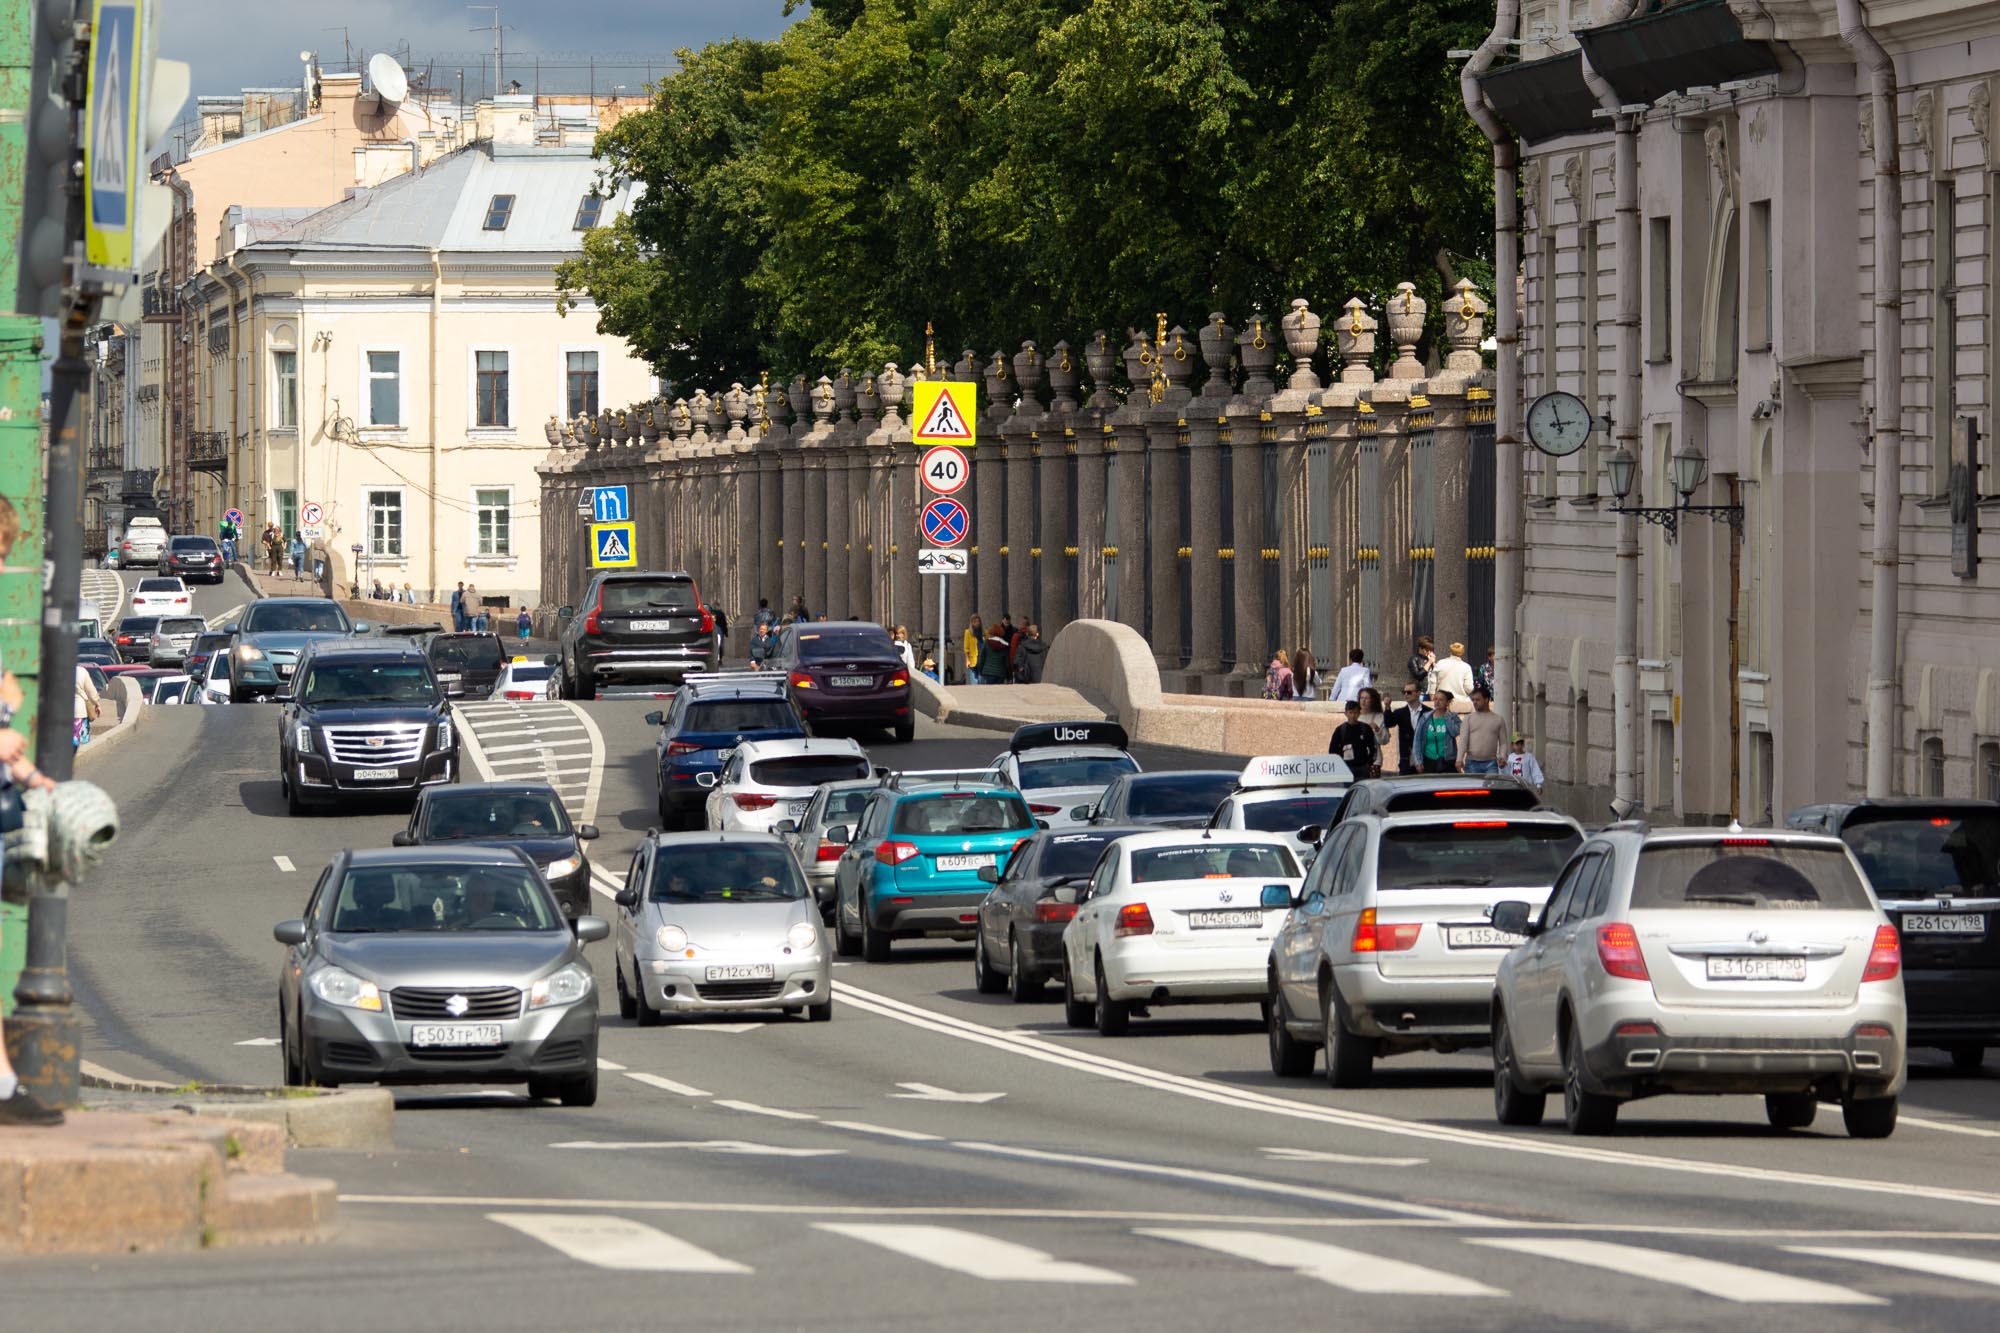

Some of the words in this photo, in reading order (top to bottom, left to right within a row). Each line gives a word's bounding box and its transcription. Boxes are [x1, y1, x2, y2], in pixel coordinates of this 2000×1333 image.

[931, 461, 958, 479] 40
[305, 529, 314, 537] 50
[1054, 727, 1090, 741] Uber
[1261, 760, 1302, 776] Яндекс
[1303, 759, 1336, 774] Такси
